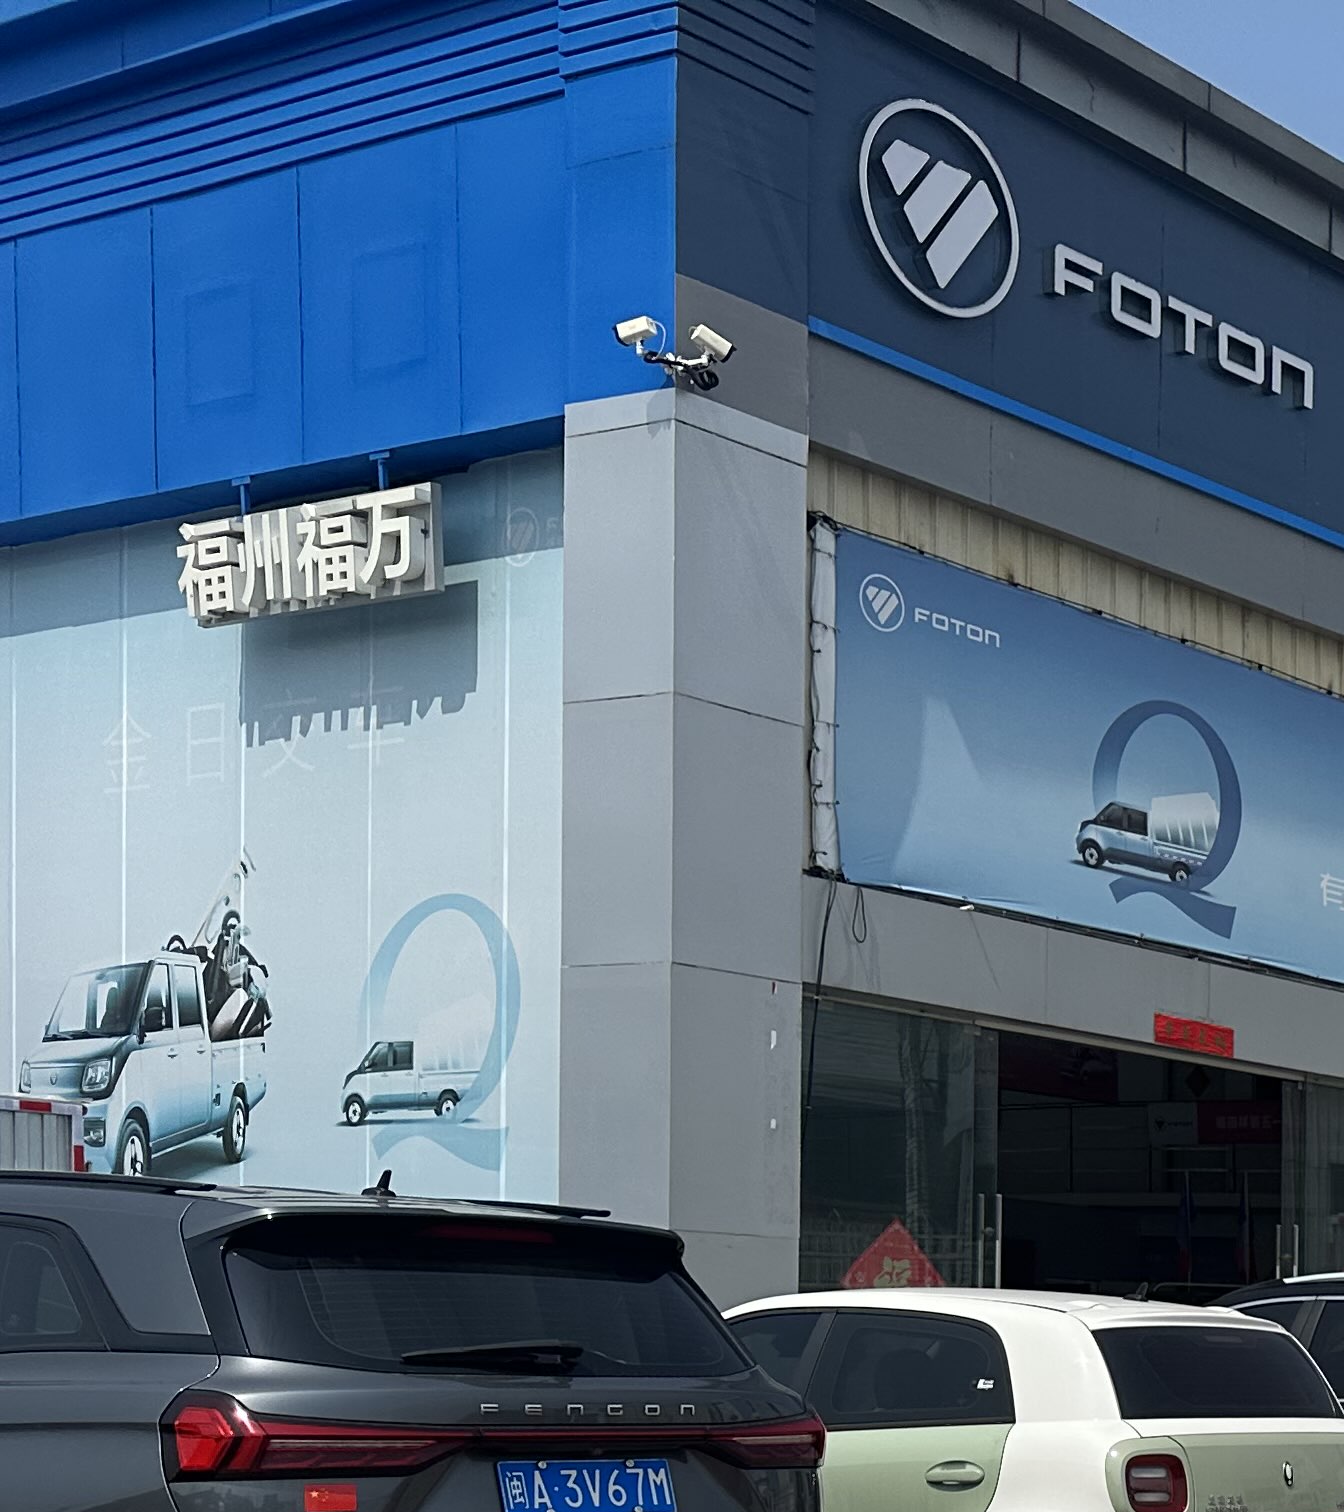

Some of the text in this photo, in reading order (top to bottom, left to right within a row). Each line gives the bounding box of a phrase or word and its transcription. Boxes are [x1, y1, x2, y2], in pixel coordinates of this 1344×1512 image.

[1053, 242, 1315, 411] FOTON
[176, 487, 414, 617] 福州福万
[914, 608, 1001, 648] FOTON
[480, 1403, 696, 1416] FENGON
[505, 1467, 672, 1510] 闽A·3V67M
